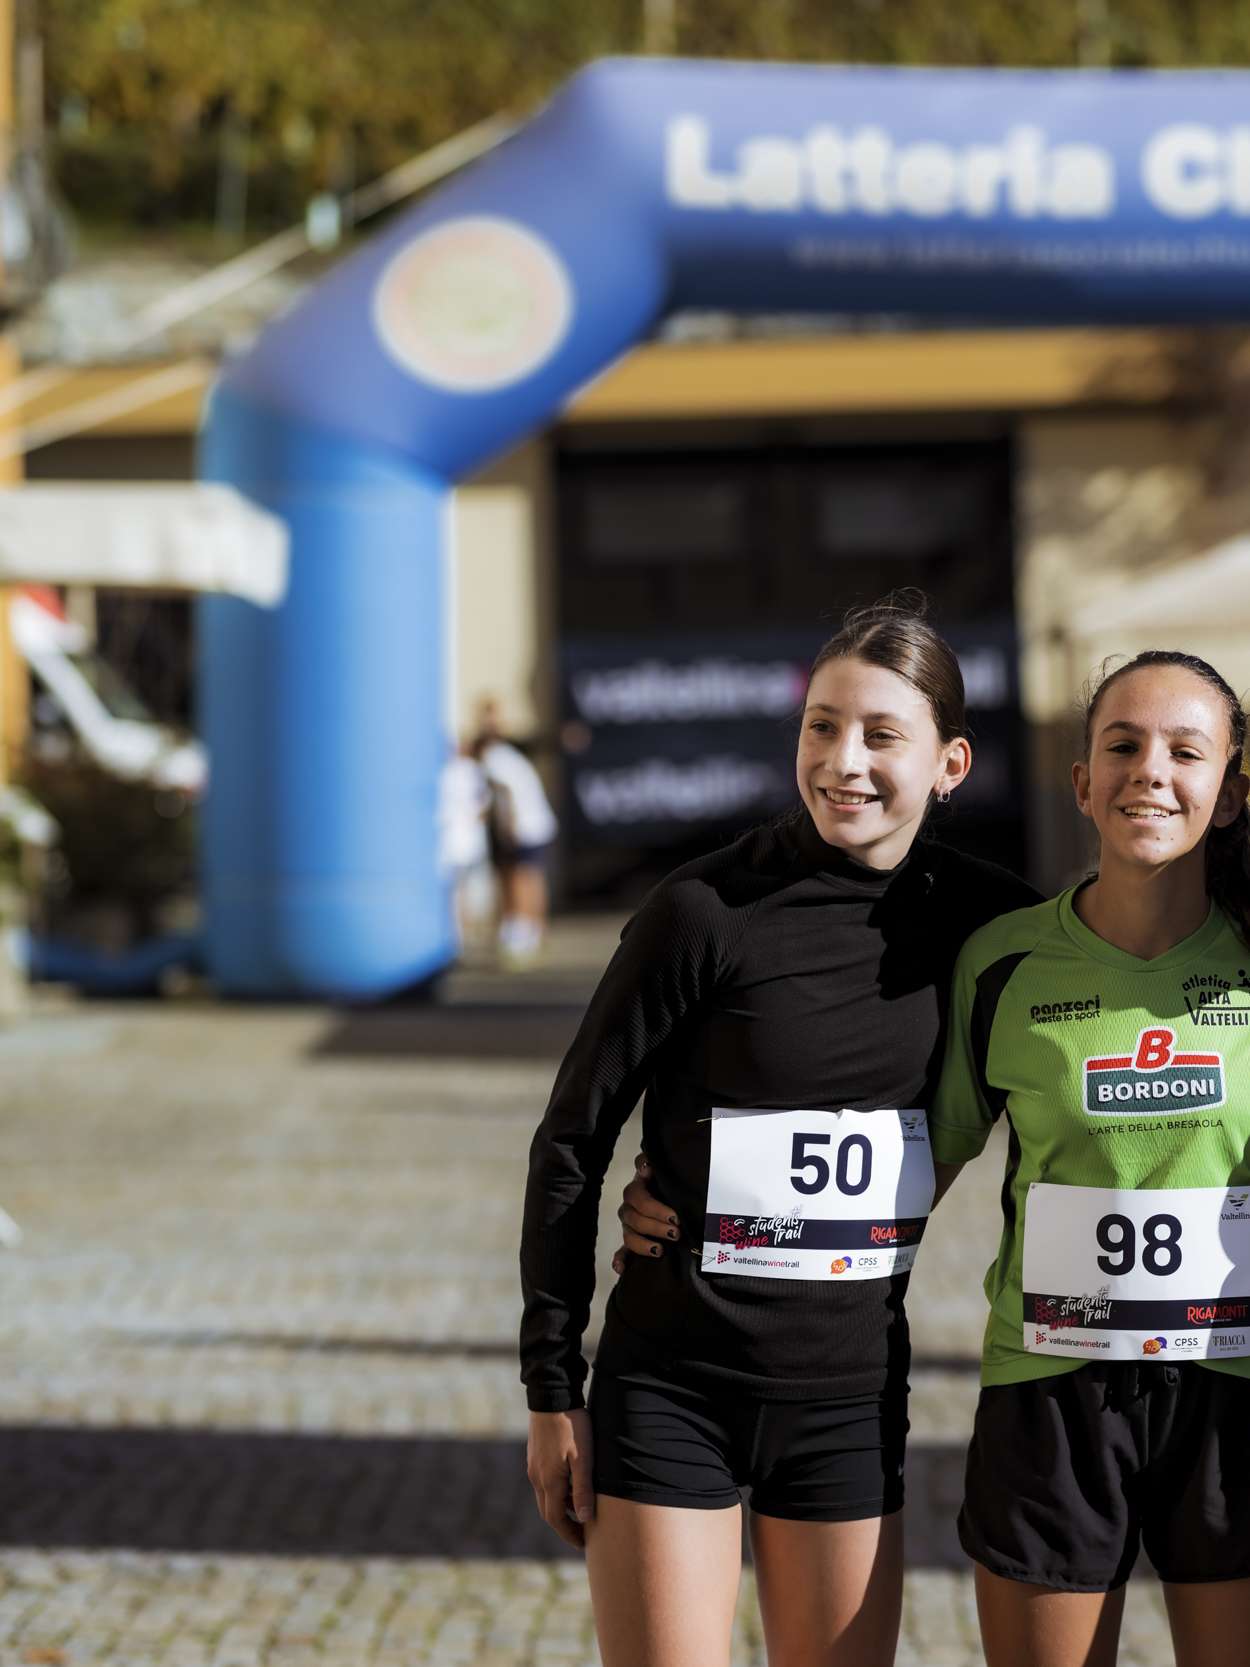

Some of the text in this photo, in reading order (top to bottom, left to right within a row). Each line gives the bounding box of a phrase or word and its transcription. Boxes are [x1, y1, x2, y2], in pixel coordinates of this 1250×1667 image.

[666, 114, 1114, 219] Latteria
[1182, 973, 1231, 991] atletica
[1030, 995, 1100, 1018] panzeri
[1198, 991, 1231, 1005] ALTA
[1036, 1009, 1100, 1024] veste lo sport
[1135, 1029, 1173, 1070] B
[1098, 1079, 1215, 1102] BORDONI
[1088, 1118, 1223, 1136] L'ARTE DELLA BRESAOLA
[790, 1133, 872, 1196] 50
[773, 1221, 804, 1245] trail
[870, 1226, 918, 1244] RIGAMONTI
[735, 1236, 769, 1250] wine
[1096, 1213, 1182, 1276] 98
[734, 1257, 799, 1268] valtellinawinetrail
[858, 1257, 877, 1266] CPSS
[1083, 1302, 1112, 1326] trail
[1187, 1305, 1246, 1324] RIGAMONTI
[1049, 1316, 1079, 1331] wine
[1049, 1337, 1110, 1348] valtellinawinetrail
[1174, 1338, 1198, 1347] CPSS
[1212, 1335, 1246, 1347] TRIACCA
